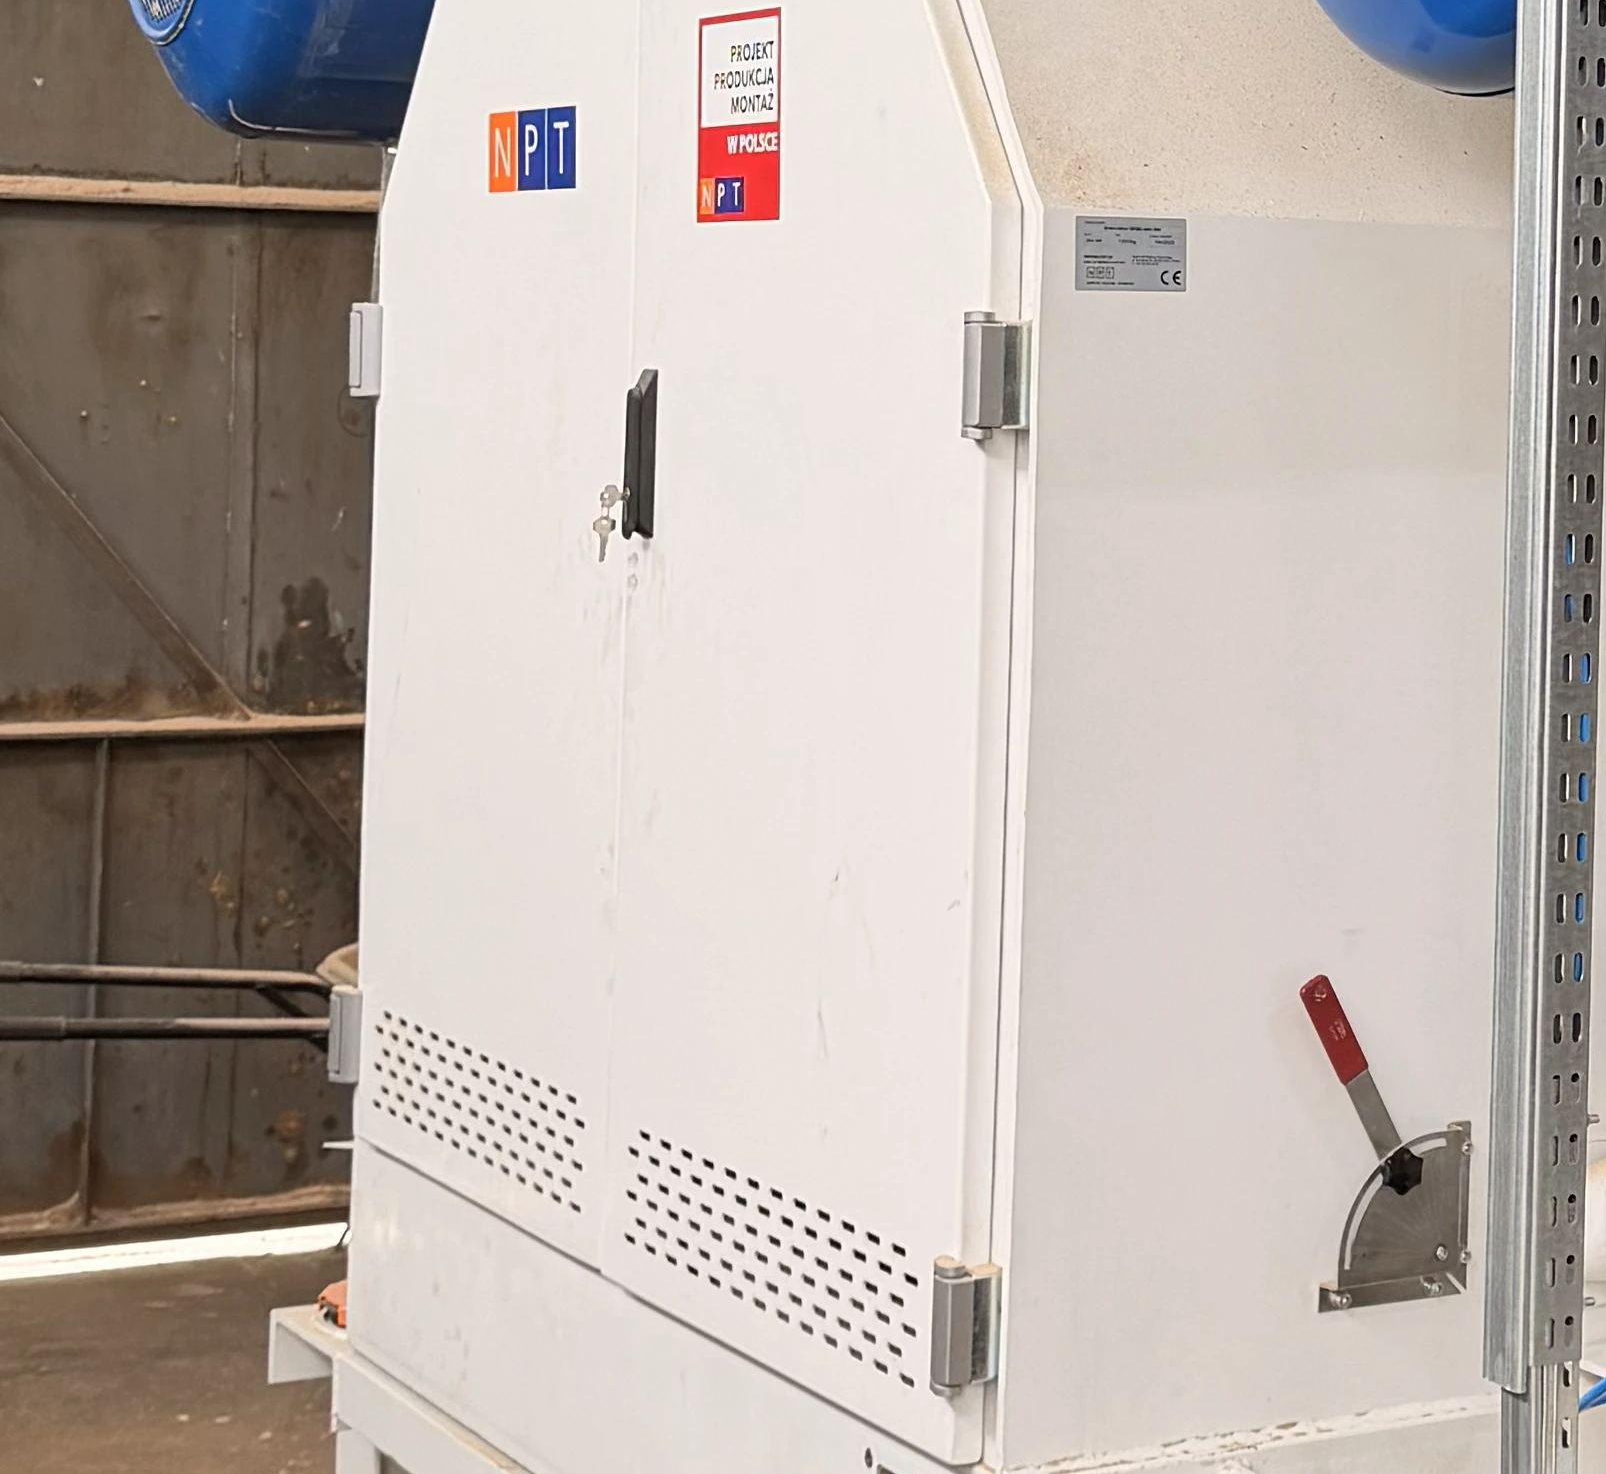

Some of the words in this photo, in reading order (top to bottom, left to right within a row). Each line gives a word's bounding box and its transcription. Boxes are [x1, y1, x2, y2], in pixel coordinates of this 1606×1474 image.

[730, 40, 774, 62] PROJEKT
[714, 67, 774, 90] PRODUKCJA
[730, 87, 774, 114] MONTAŻ
[493, 120, 570, 179] NPT
[727, 134, 739, 155] W
[740, 131, 779, 153] POLSCE
[701, 181, 742, 208] NPT
